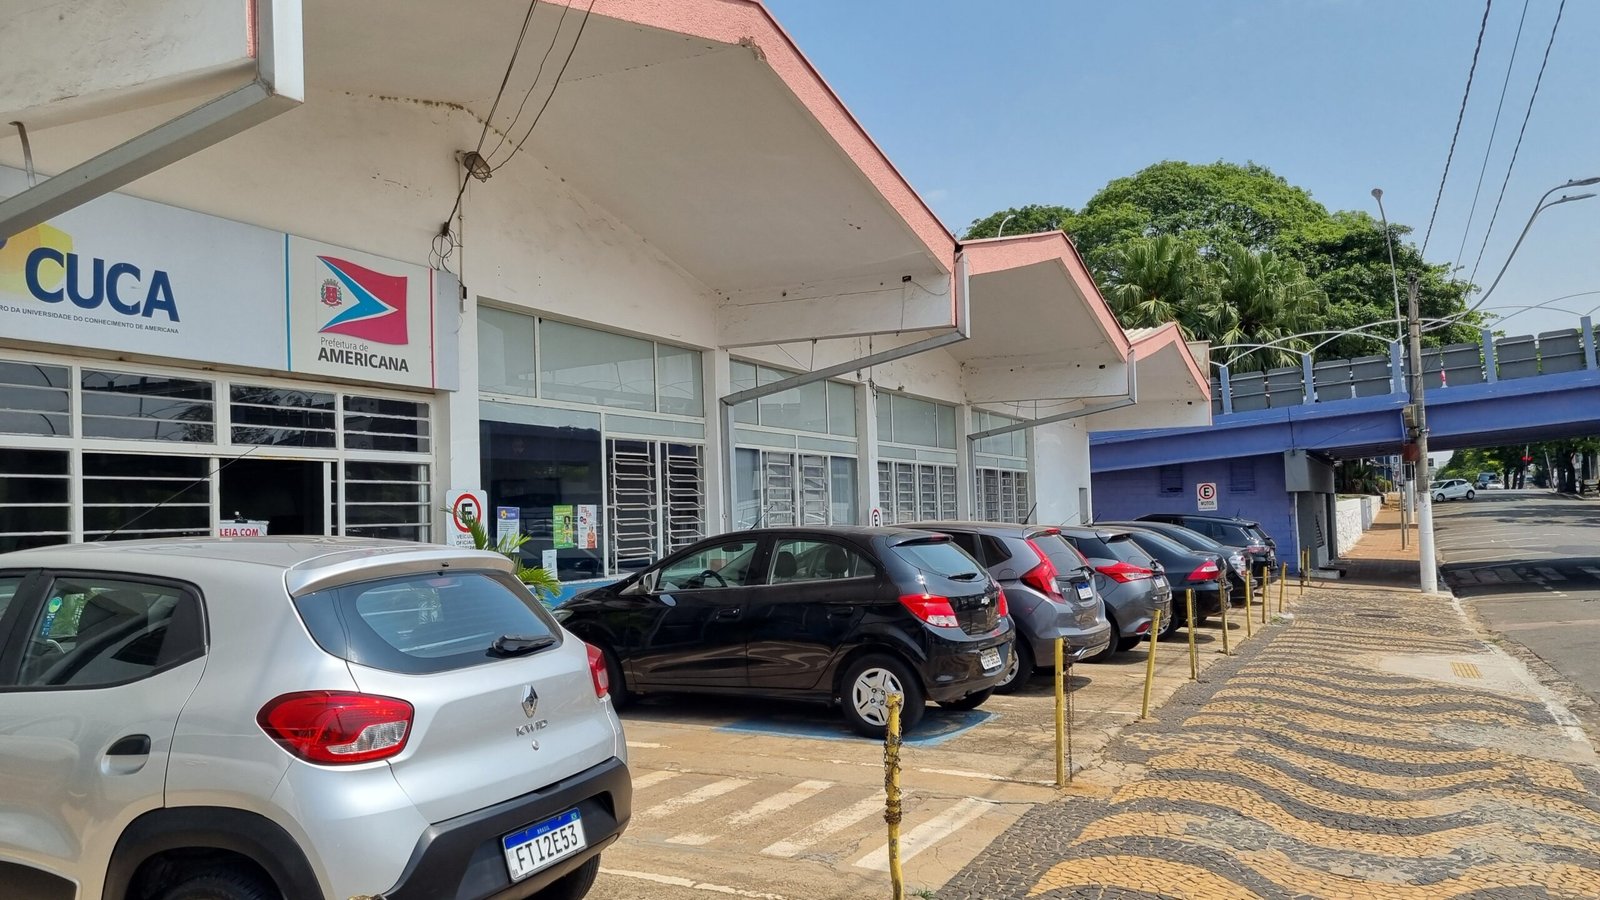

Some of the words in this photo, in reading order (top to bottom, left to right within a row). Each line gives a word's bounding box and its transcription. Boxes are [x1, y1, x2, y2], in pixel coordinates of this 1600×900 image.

[25, 247, 180, 322] CUCA
[22, 308, 72, 321] UNIVERSIDADE
[85, 317, 134, 329] CONHECIMENTO
[145, 325, 179, 334] AMERICANA
[320, 337, 358, 351] Prefeitura
[359, 343, 368, 352] de
[318, 347, 409, 373] AMERICANA
[1203, 487, 1210, 497] E
[462, 503, 472, 523] E
[874, 514, 879, 527] E
[220, 528, 238, 537] LEIA
[240, 528, 259, 537] COM
[515, 719, 549, 737] KWID
[515, 824, 578, 871] FTI2E53
